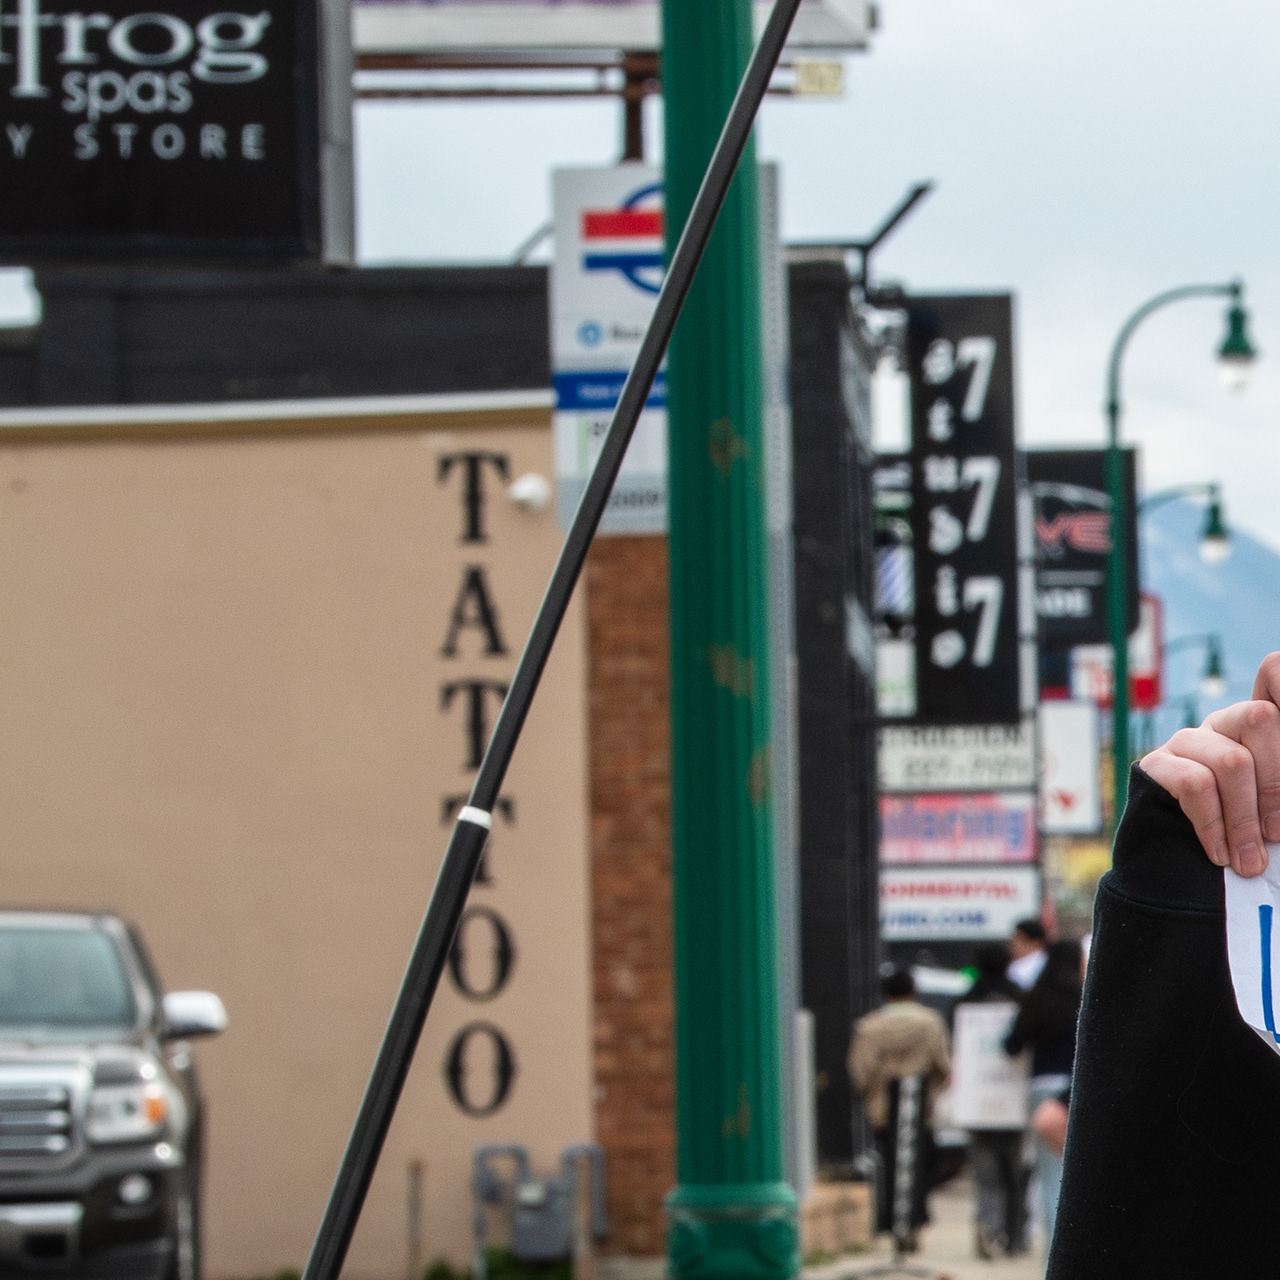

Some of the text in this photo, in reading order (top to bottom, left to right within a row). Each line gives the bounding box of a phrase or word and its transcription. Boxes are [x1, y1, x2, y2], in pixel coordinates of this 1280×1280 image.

[0, 0, 270, 97] frog
[61, 71, 193, 122] spas
[73, 123, 266, 160] STORE
